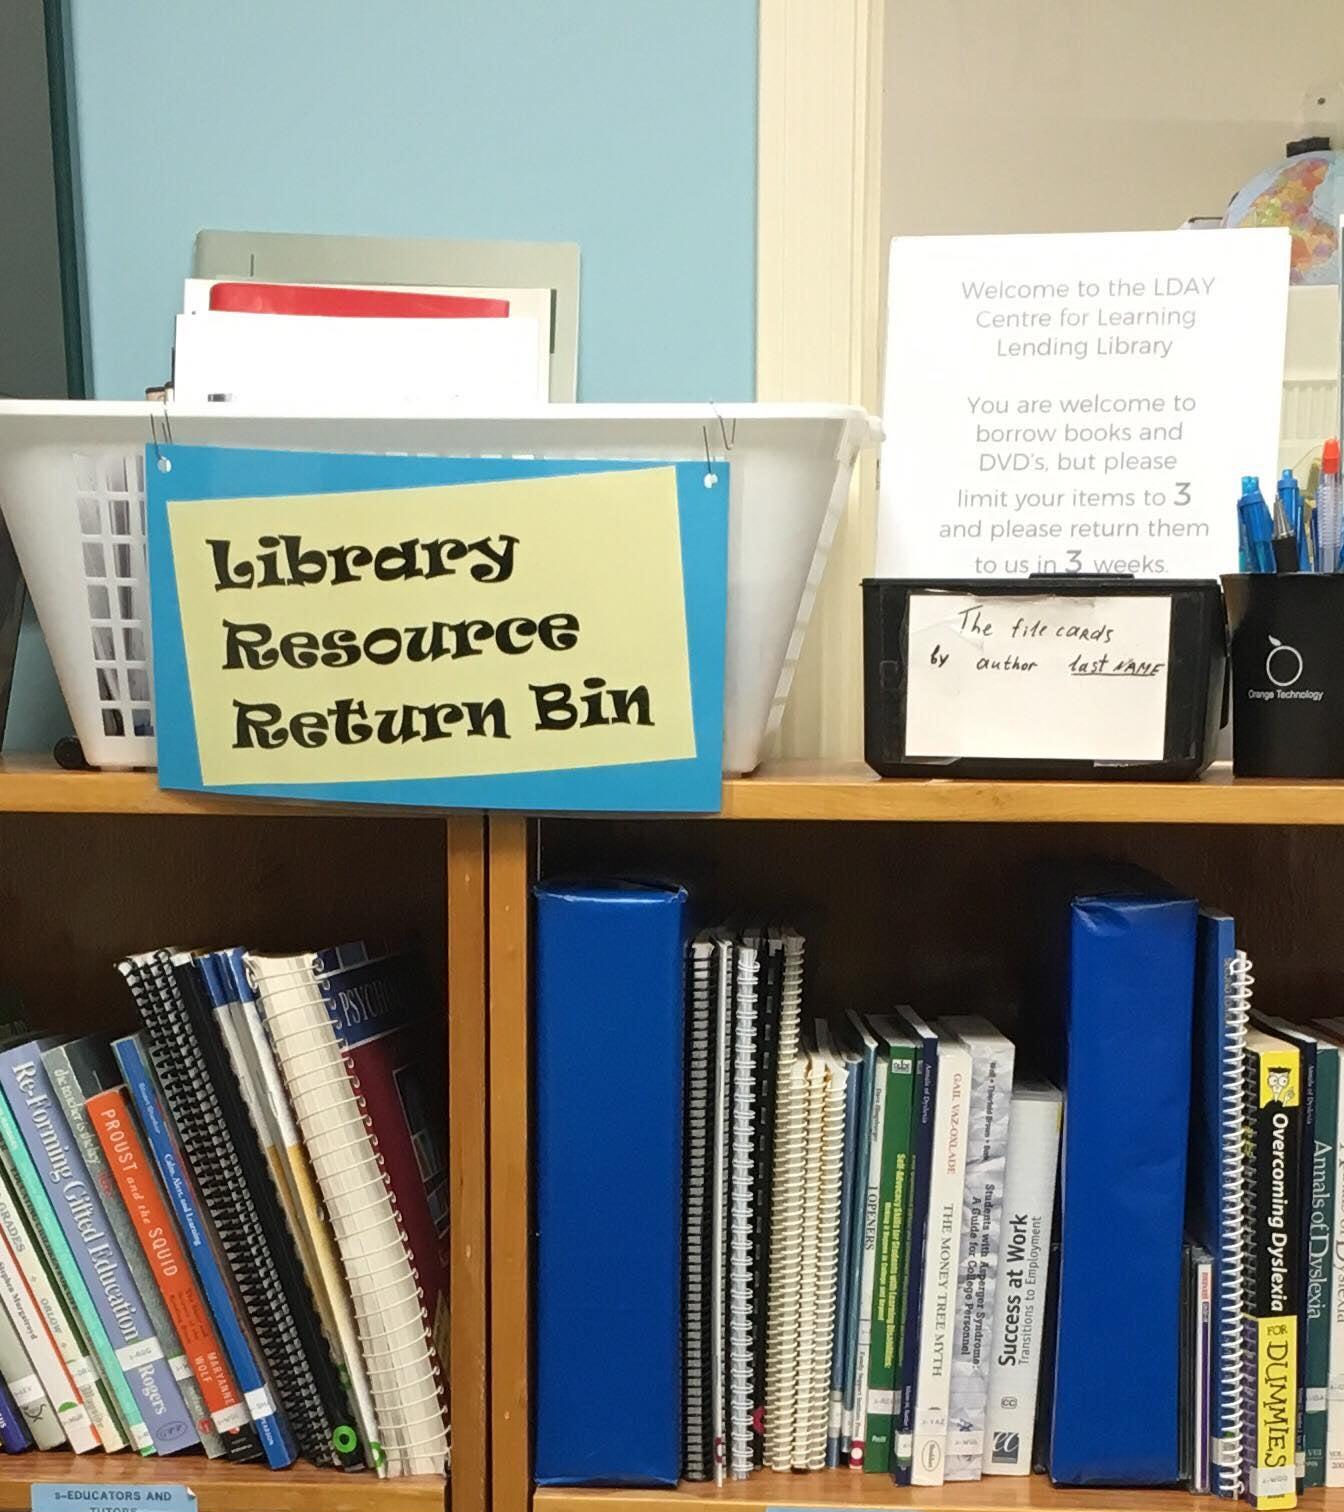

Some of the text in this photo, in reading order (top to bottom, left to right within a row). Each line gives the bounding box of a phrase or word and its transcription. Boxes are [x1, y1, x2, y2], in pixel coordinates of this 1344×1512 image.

[961, 277, 1216, 301] Welcome to the LDAY
[975, 306, 1197, 330] Centre for Learning
[996, 336, 1173, 359] Lending Library
[967, 396, 1197, 415] You are welcome to
[975, 422, 1184, 444] borrow books and
[1058, 451, 1096, 471] but
[1103, 452, 1178, 474] please
[958, 483, 1191, 512] limit your items to 3
[939, 519, 1210, 543] and please return them
[205, 534, 520, 592] Library
[975, 557, 998, 575] to
[1004, 559, 1029, 575] us
[1037, 554, 1057, 574] in
[1065, 549, 1084, 576] 3
[958, 605, 993, 638] The
[221, 611, 581, 671] Resource
[930, 648, 949, 668] by
[976, 656, 1038, 673] author
[1070, 654, 1110, 674] last
[1248, 687, 1323, 701] Orange Technology
[232, 677, 656, 751] Return Bin
[1267, 1112, 1289, 1311] Overcoming Dyslexia
[998, 1213, 1028, 1367] Success at Work
[1264, 1325, 1288, 1468] FOR DUMMIES
[146, 1491, 172, 1502] AND
